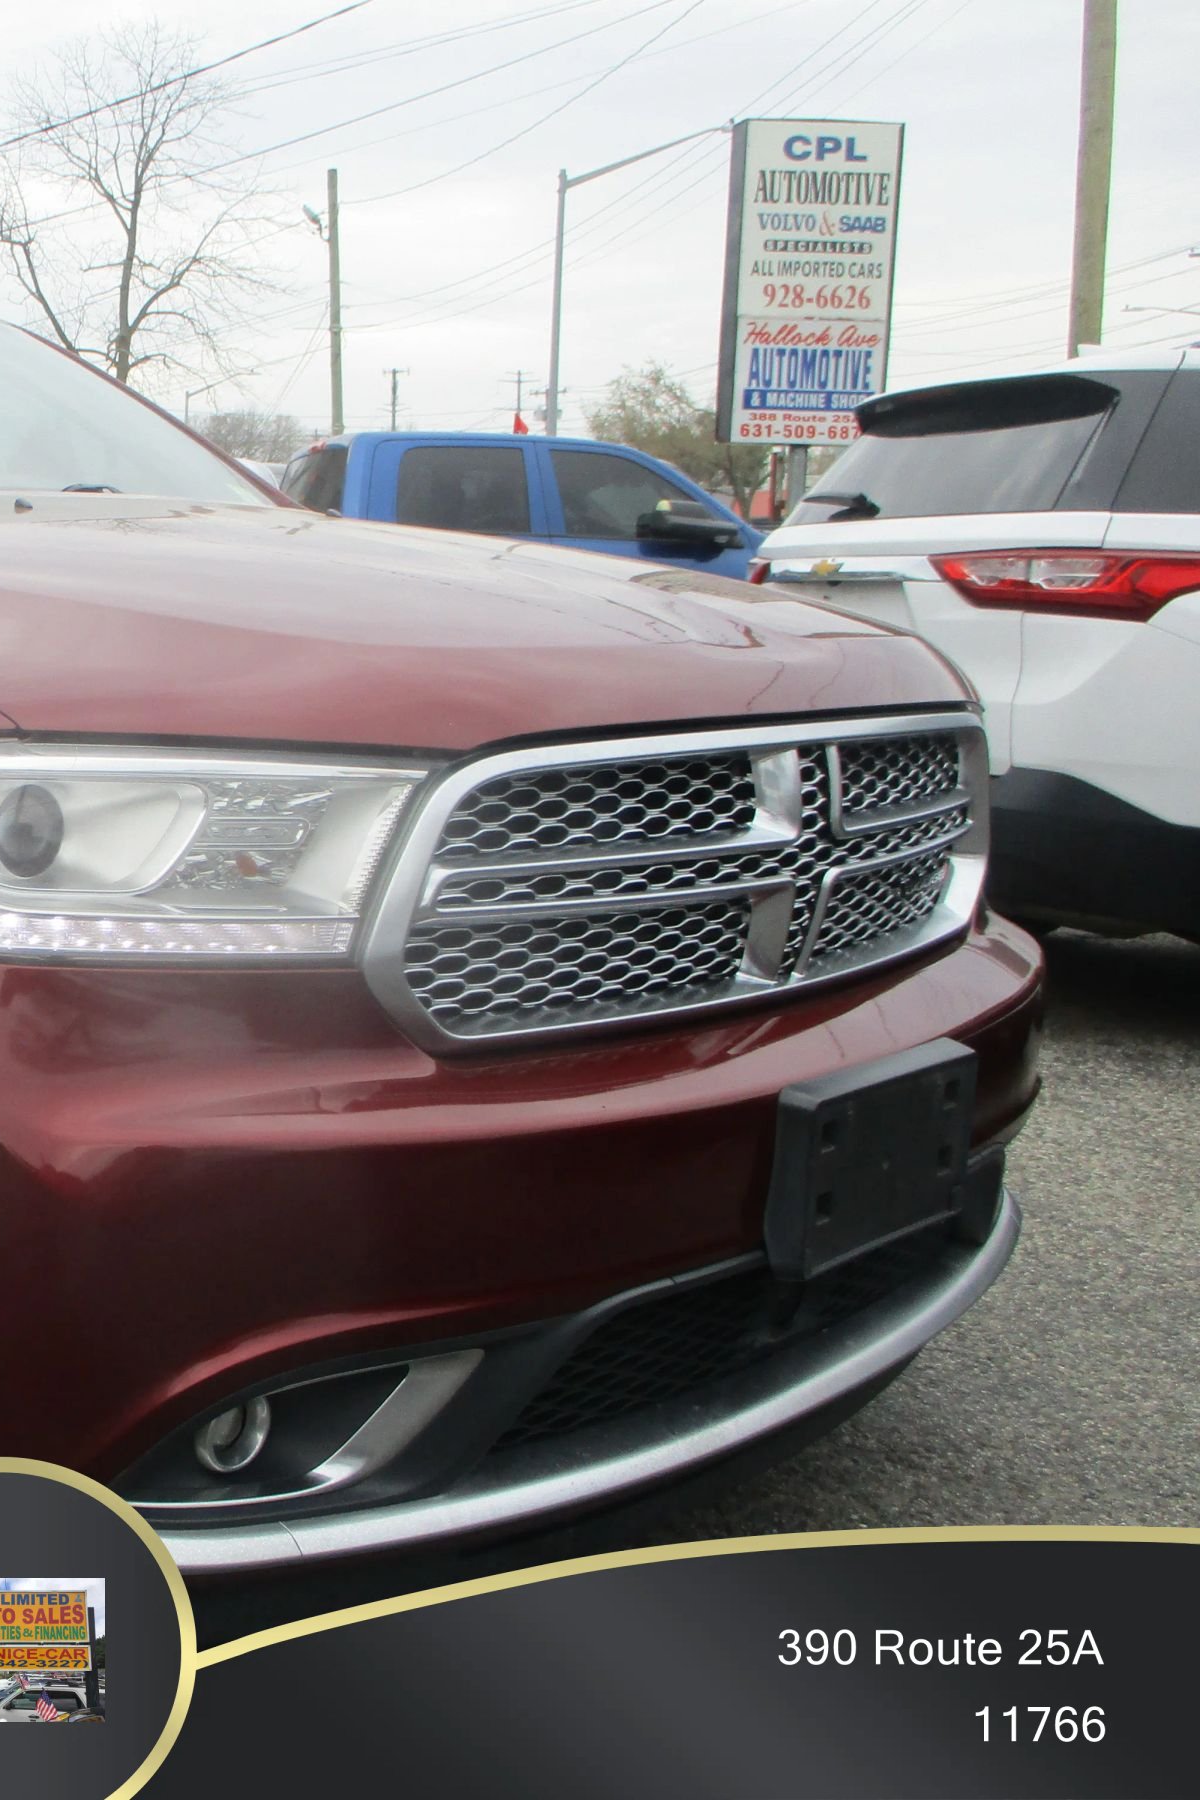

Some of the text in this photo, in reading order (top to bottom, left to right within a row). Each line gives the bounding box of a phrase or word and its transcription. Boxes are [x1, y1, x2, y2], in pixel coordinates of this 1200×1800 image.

[783, 135, 868, 162] CPL
[753, 169, 890, 206] AUTOMOTIVE
[757, 211, 886, 236] VOLVO & SAAB
[765, 240, 872, 254] SPECIALISTS
[750, 260, 883, 279] ALL IMPORTED CARS
[763, 284, 871, 309] 928-6626
[743, 322, 880, 347] Hallock Ave
[749, 348, 873, 390] AUTOMOTIVE
[751, 392, 761, 407] &
[766, 392, 826, 409] MACHINE
[749, 412, 777, 421] 388
[783, 413, 827, 423] Route
[740, 424, 864, 440] 631-509-687
